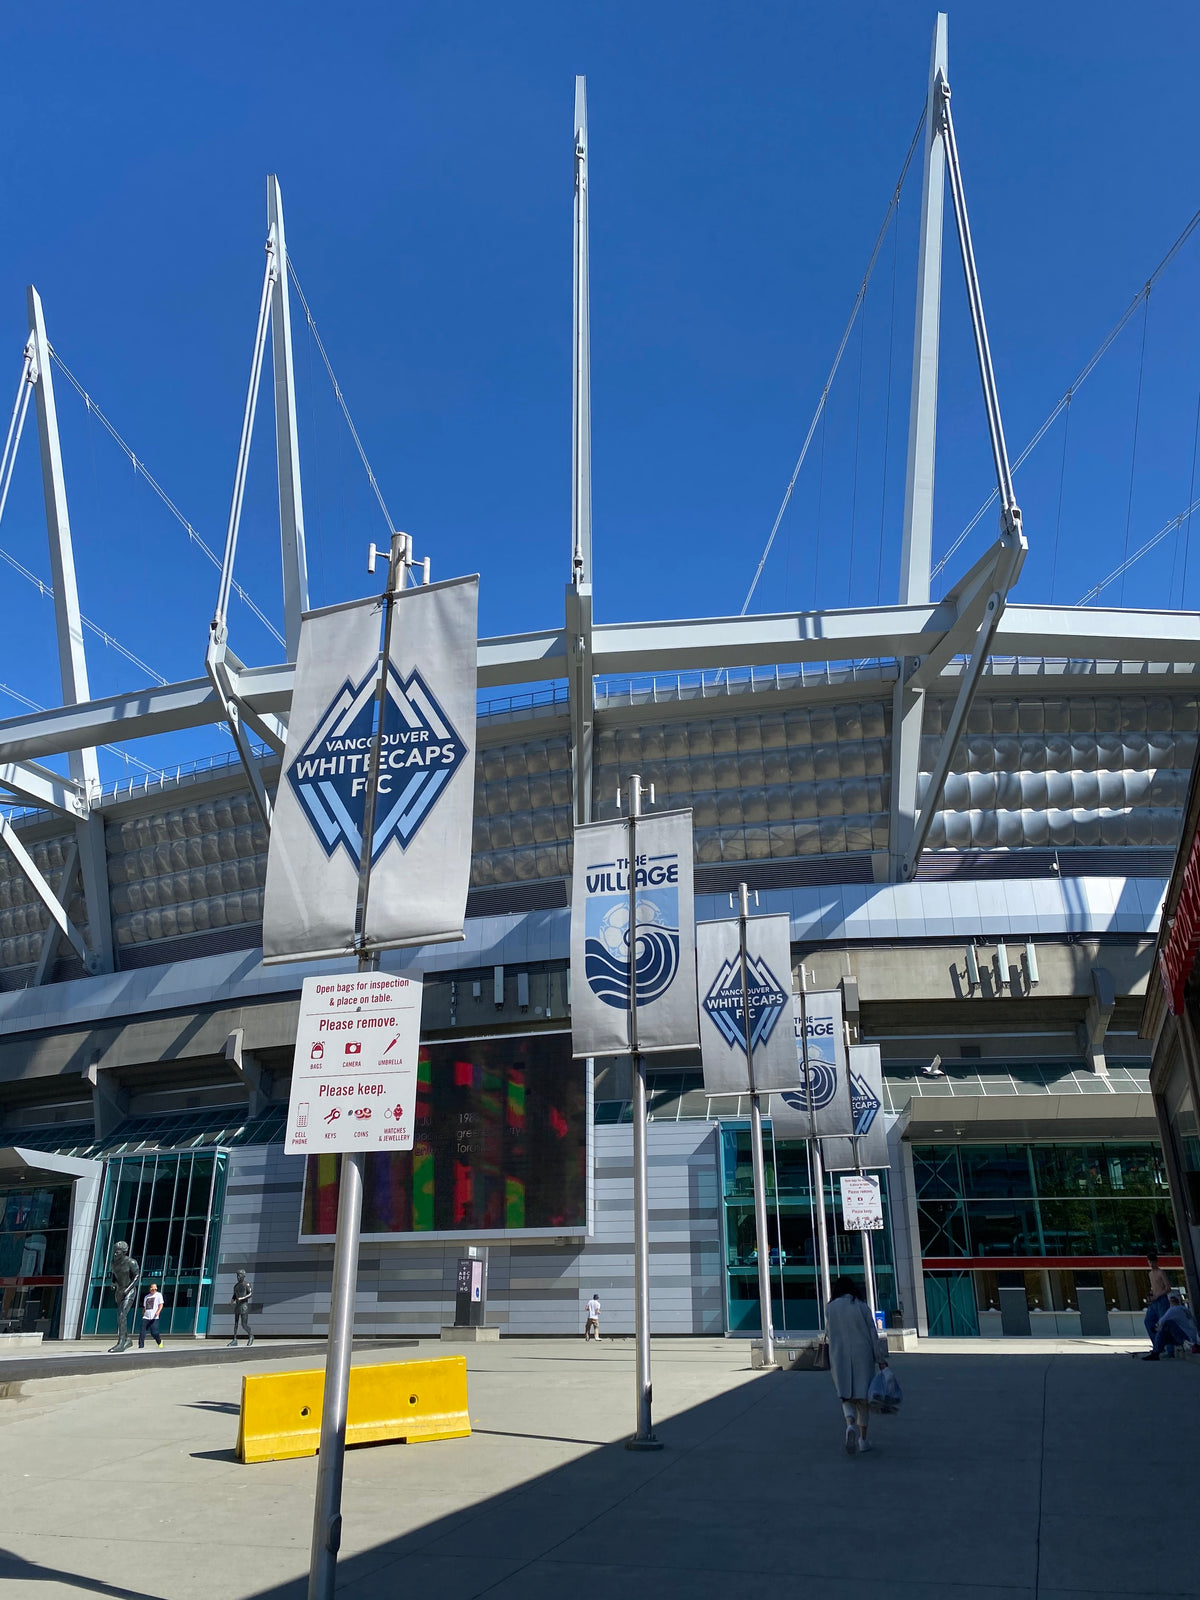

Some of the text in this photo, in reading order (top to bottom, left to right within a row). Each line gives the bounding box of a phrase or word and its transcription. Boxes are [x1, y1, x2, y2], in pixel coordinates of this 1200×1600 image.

[326, 731, 429, 751] VANCOUVER
[296, 744, 456, 779] WHITECAPS
[351, 774, 393, 797] FC
[617, 854, 647, 869] THE
[586, 864, 678, 893] VILLAGE
[316, 978, 410, 995] Open bags for inspection
[720, 986, 770, 996] VANCOUVER
[329, 993, 393, 1007] & place on table.
[706, 994, 783, 1009] WHITECAPS
[319, 1016, 399, 1031] Please remove.
[377, 1058, 403, 1066] UMBRELLA
[319, 1082, 387, 1097] Please keep.
[383, 1134, 410, 1142] JEWELLERY
